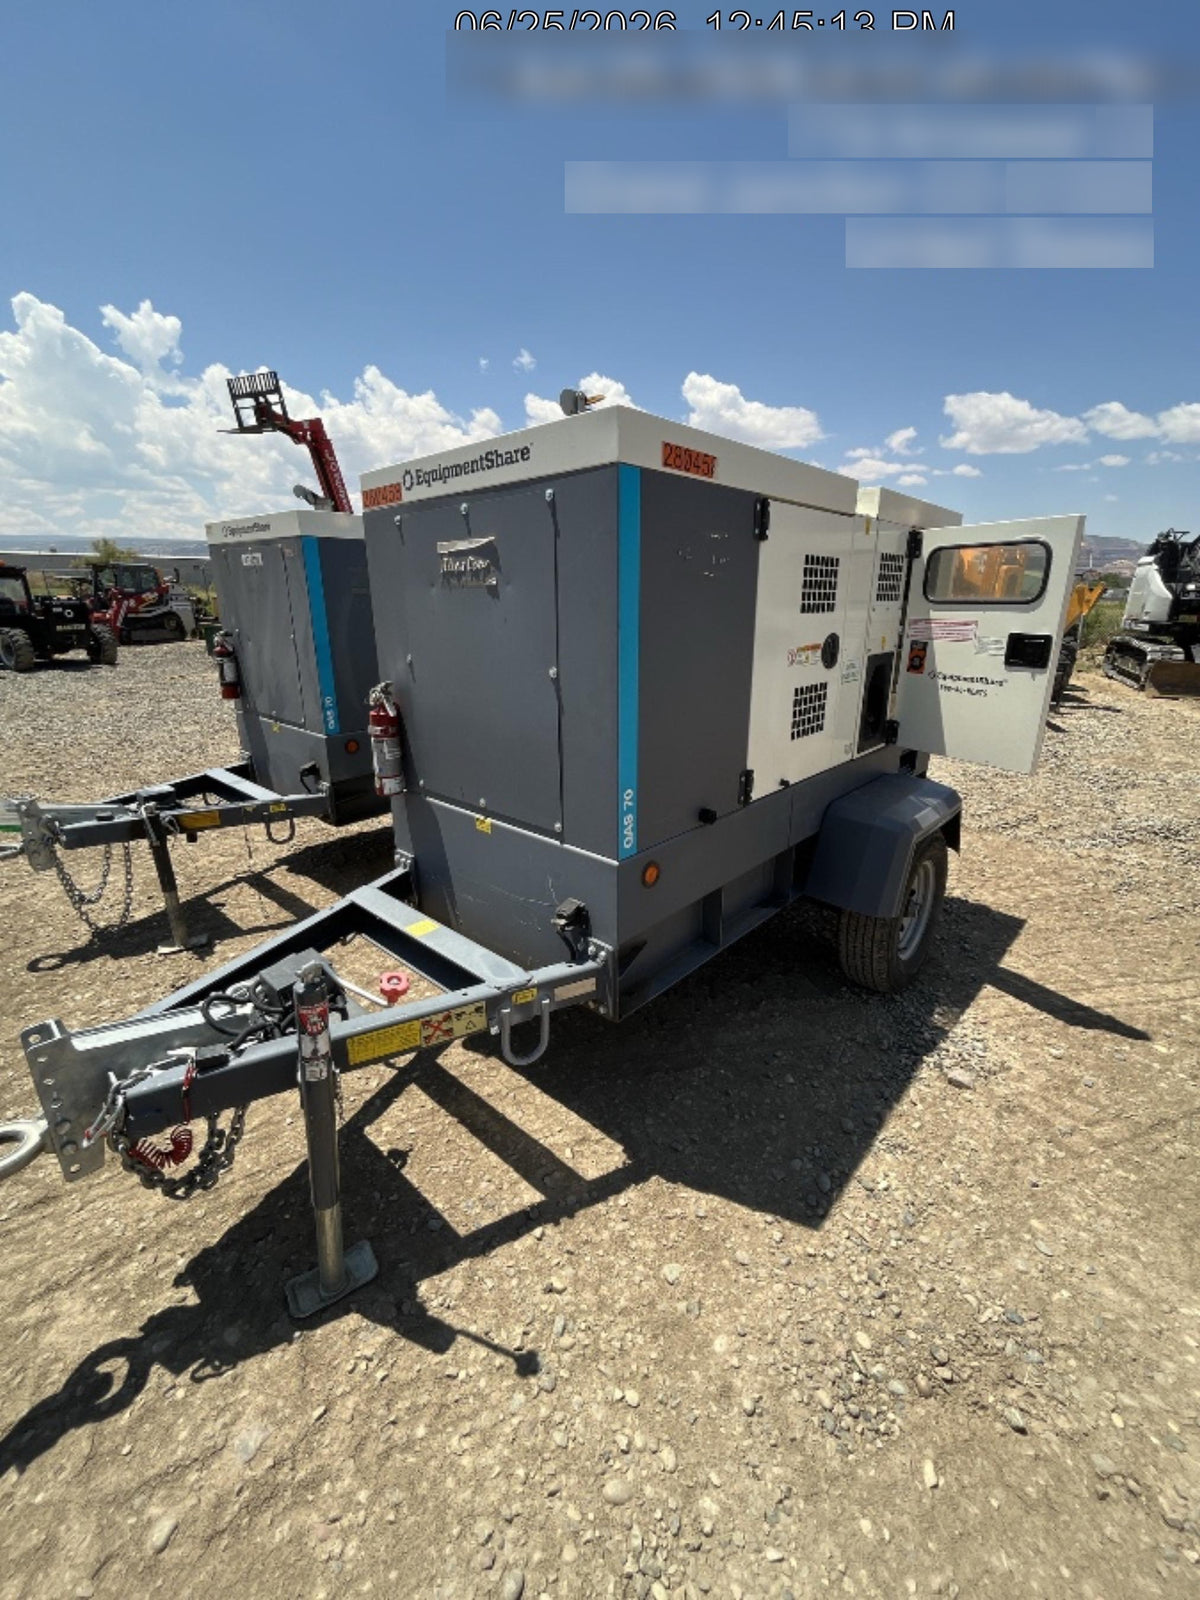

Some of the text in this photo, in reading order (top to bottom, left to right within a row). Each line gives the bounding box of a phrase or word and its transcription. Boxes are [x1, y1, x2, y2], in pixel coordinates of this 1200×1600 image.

[415, 445, 531, 488] EquipmentShare
[623, 788, 634, 849] QAS 70
